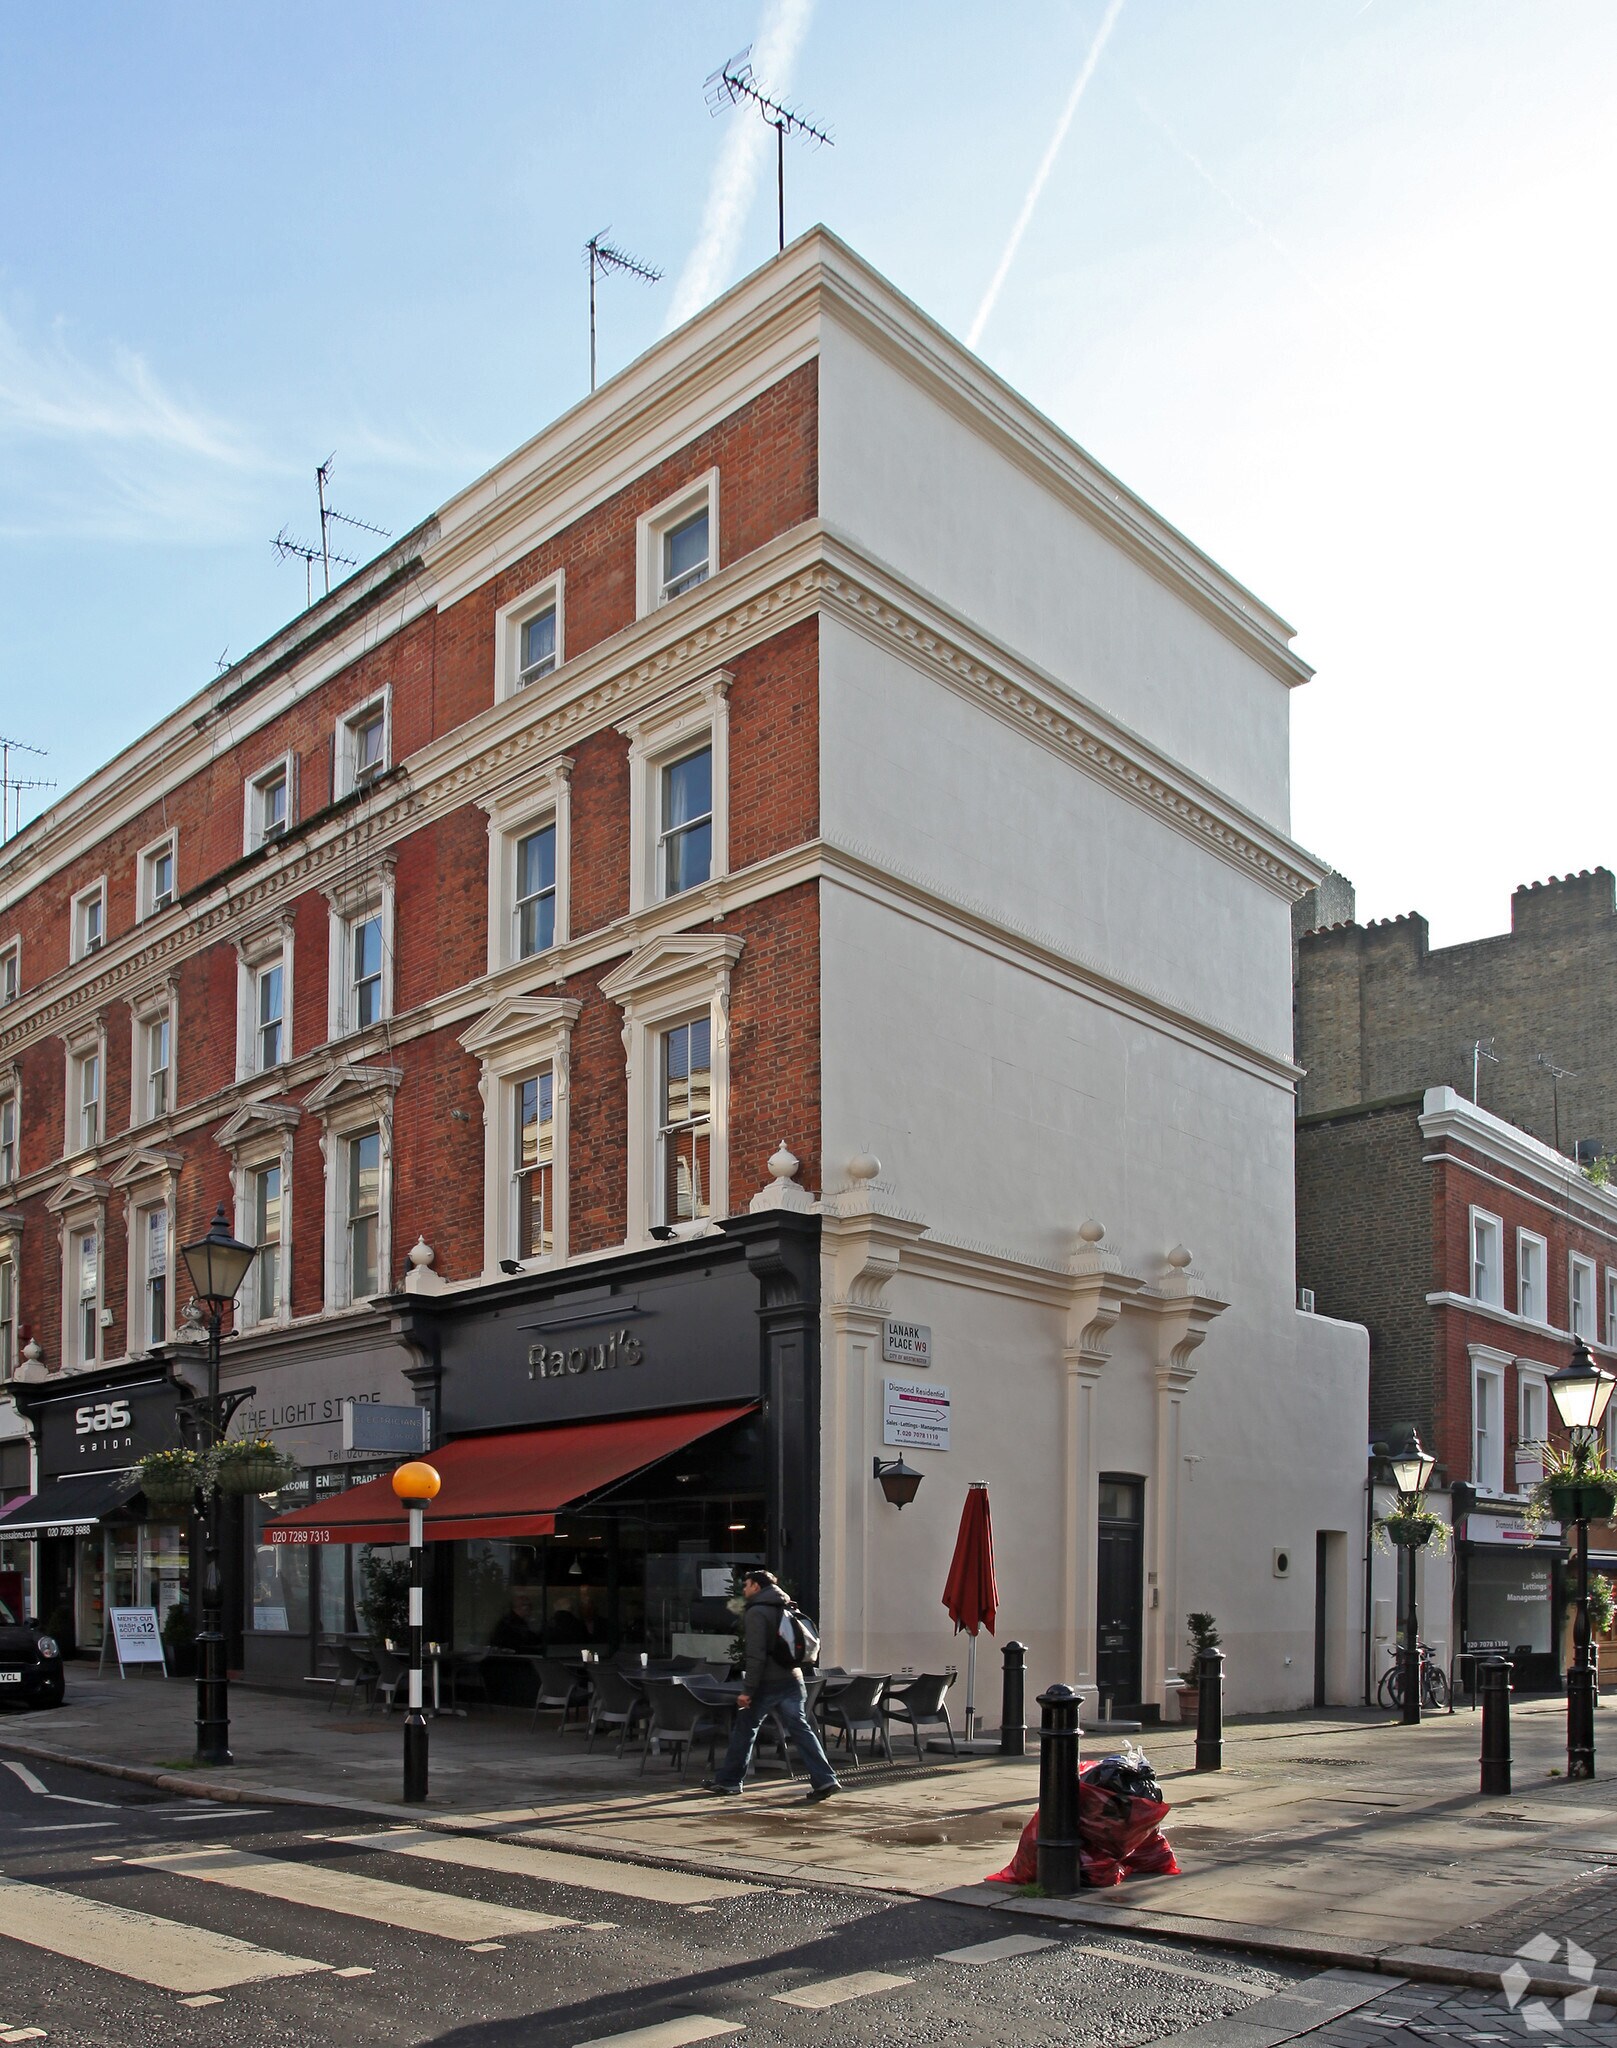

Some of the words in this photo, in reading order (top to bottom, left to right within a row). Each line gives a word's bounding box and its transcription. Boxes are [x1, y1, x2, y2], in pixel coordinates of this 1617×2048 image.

[889, 1323, 919, 1338] LANARK
[889, 1337, 912, 1350] PLACE
[914, 1341, 927, 1352] W9
[528, 1329, 641, 1380] Raoul's
[889, 1383, 915, 1394] Diamond
[915, 1387, 945, 1398] Residential
[76, 1400, 131, 1434] sas
[240, 1409, 267, 1430] THE
[272, 1402, 316, 1425] LIGHT
[886, 1419, 898, 1427] Sales
[900, 1421, 918, 1430] Lettings
[920, 1424, 948, 1432] Management
[80, 1437, 131, 1453] salon
[1496, 1519, 1513, 1530] Diamond
[47, 1527, 59, 1537] 020
[60, 1526, 73, 1536] 7286
[273, 1531, 287, 1543] 020
[289, 1531, 308, 1543] 7289
[310, 1530, 330, 1542] 7313
[1531, 1572, 1547, 1580] Sales
[1522, 1582, 1547, 1591] Lettings
[1506, 1593, 1547, 1602] Management
[136, 1622, 155, 1633] £12
[1, 1673, 18, 1681] YCL
